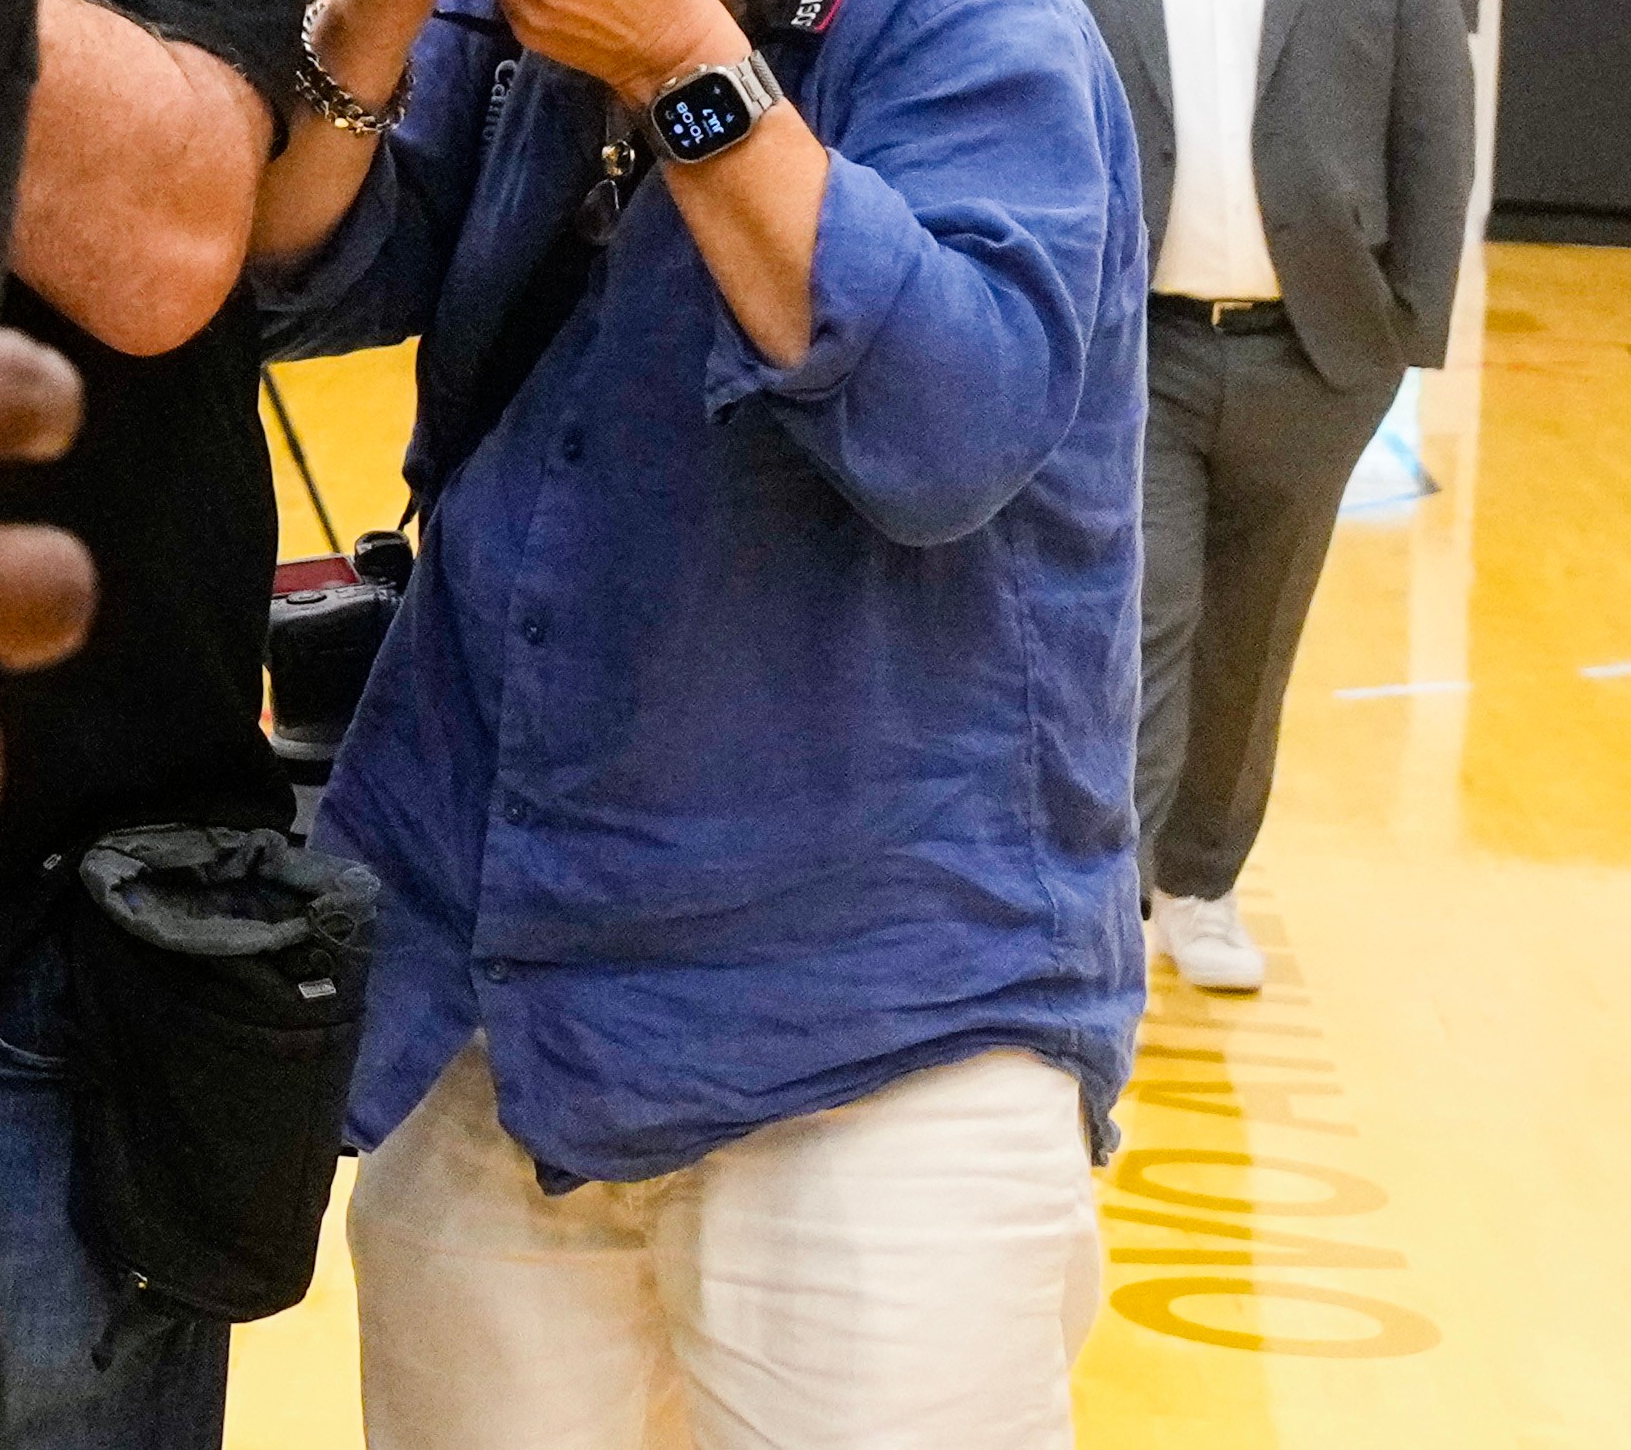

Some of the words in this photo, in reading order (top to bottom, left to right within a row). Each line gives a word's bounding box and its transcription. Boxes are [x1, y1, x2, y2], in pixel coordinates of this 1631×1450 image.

[676, 102, 705, 144] 10:08
[708, 114, 725, 134] JUL
[1100, 1147, 1442, 1359] OVO
